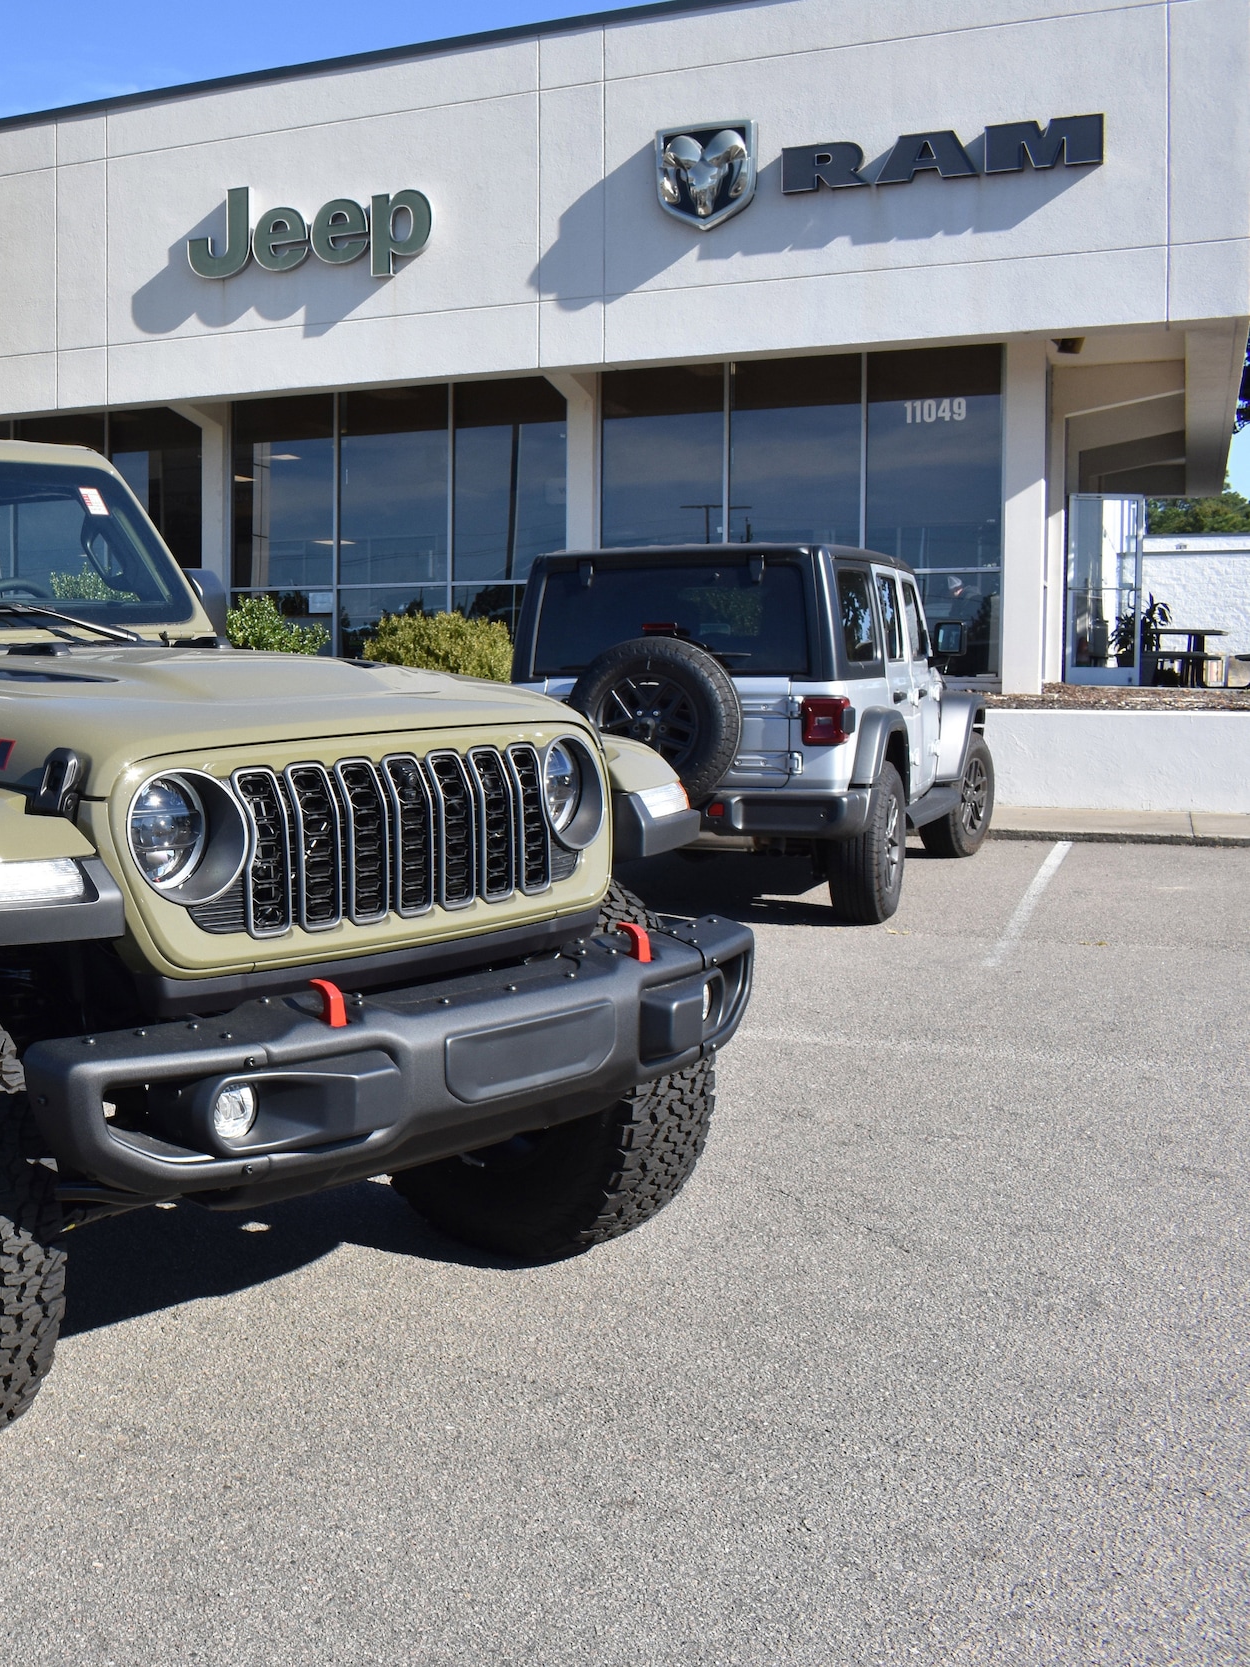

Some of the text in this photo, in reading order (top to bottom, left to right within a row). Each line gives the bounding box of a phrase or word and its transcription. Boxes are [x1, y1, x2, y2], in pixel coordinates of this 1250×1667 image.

[781, 113, 1104, 194] RAM
[187, 186, 435, 279] Jeep
[904, 398, 967, 423] 11049
